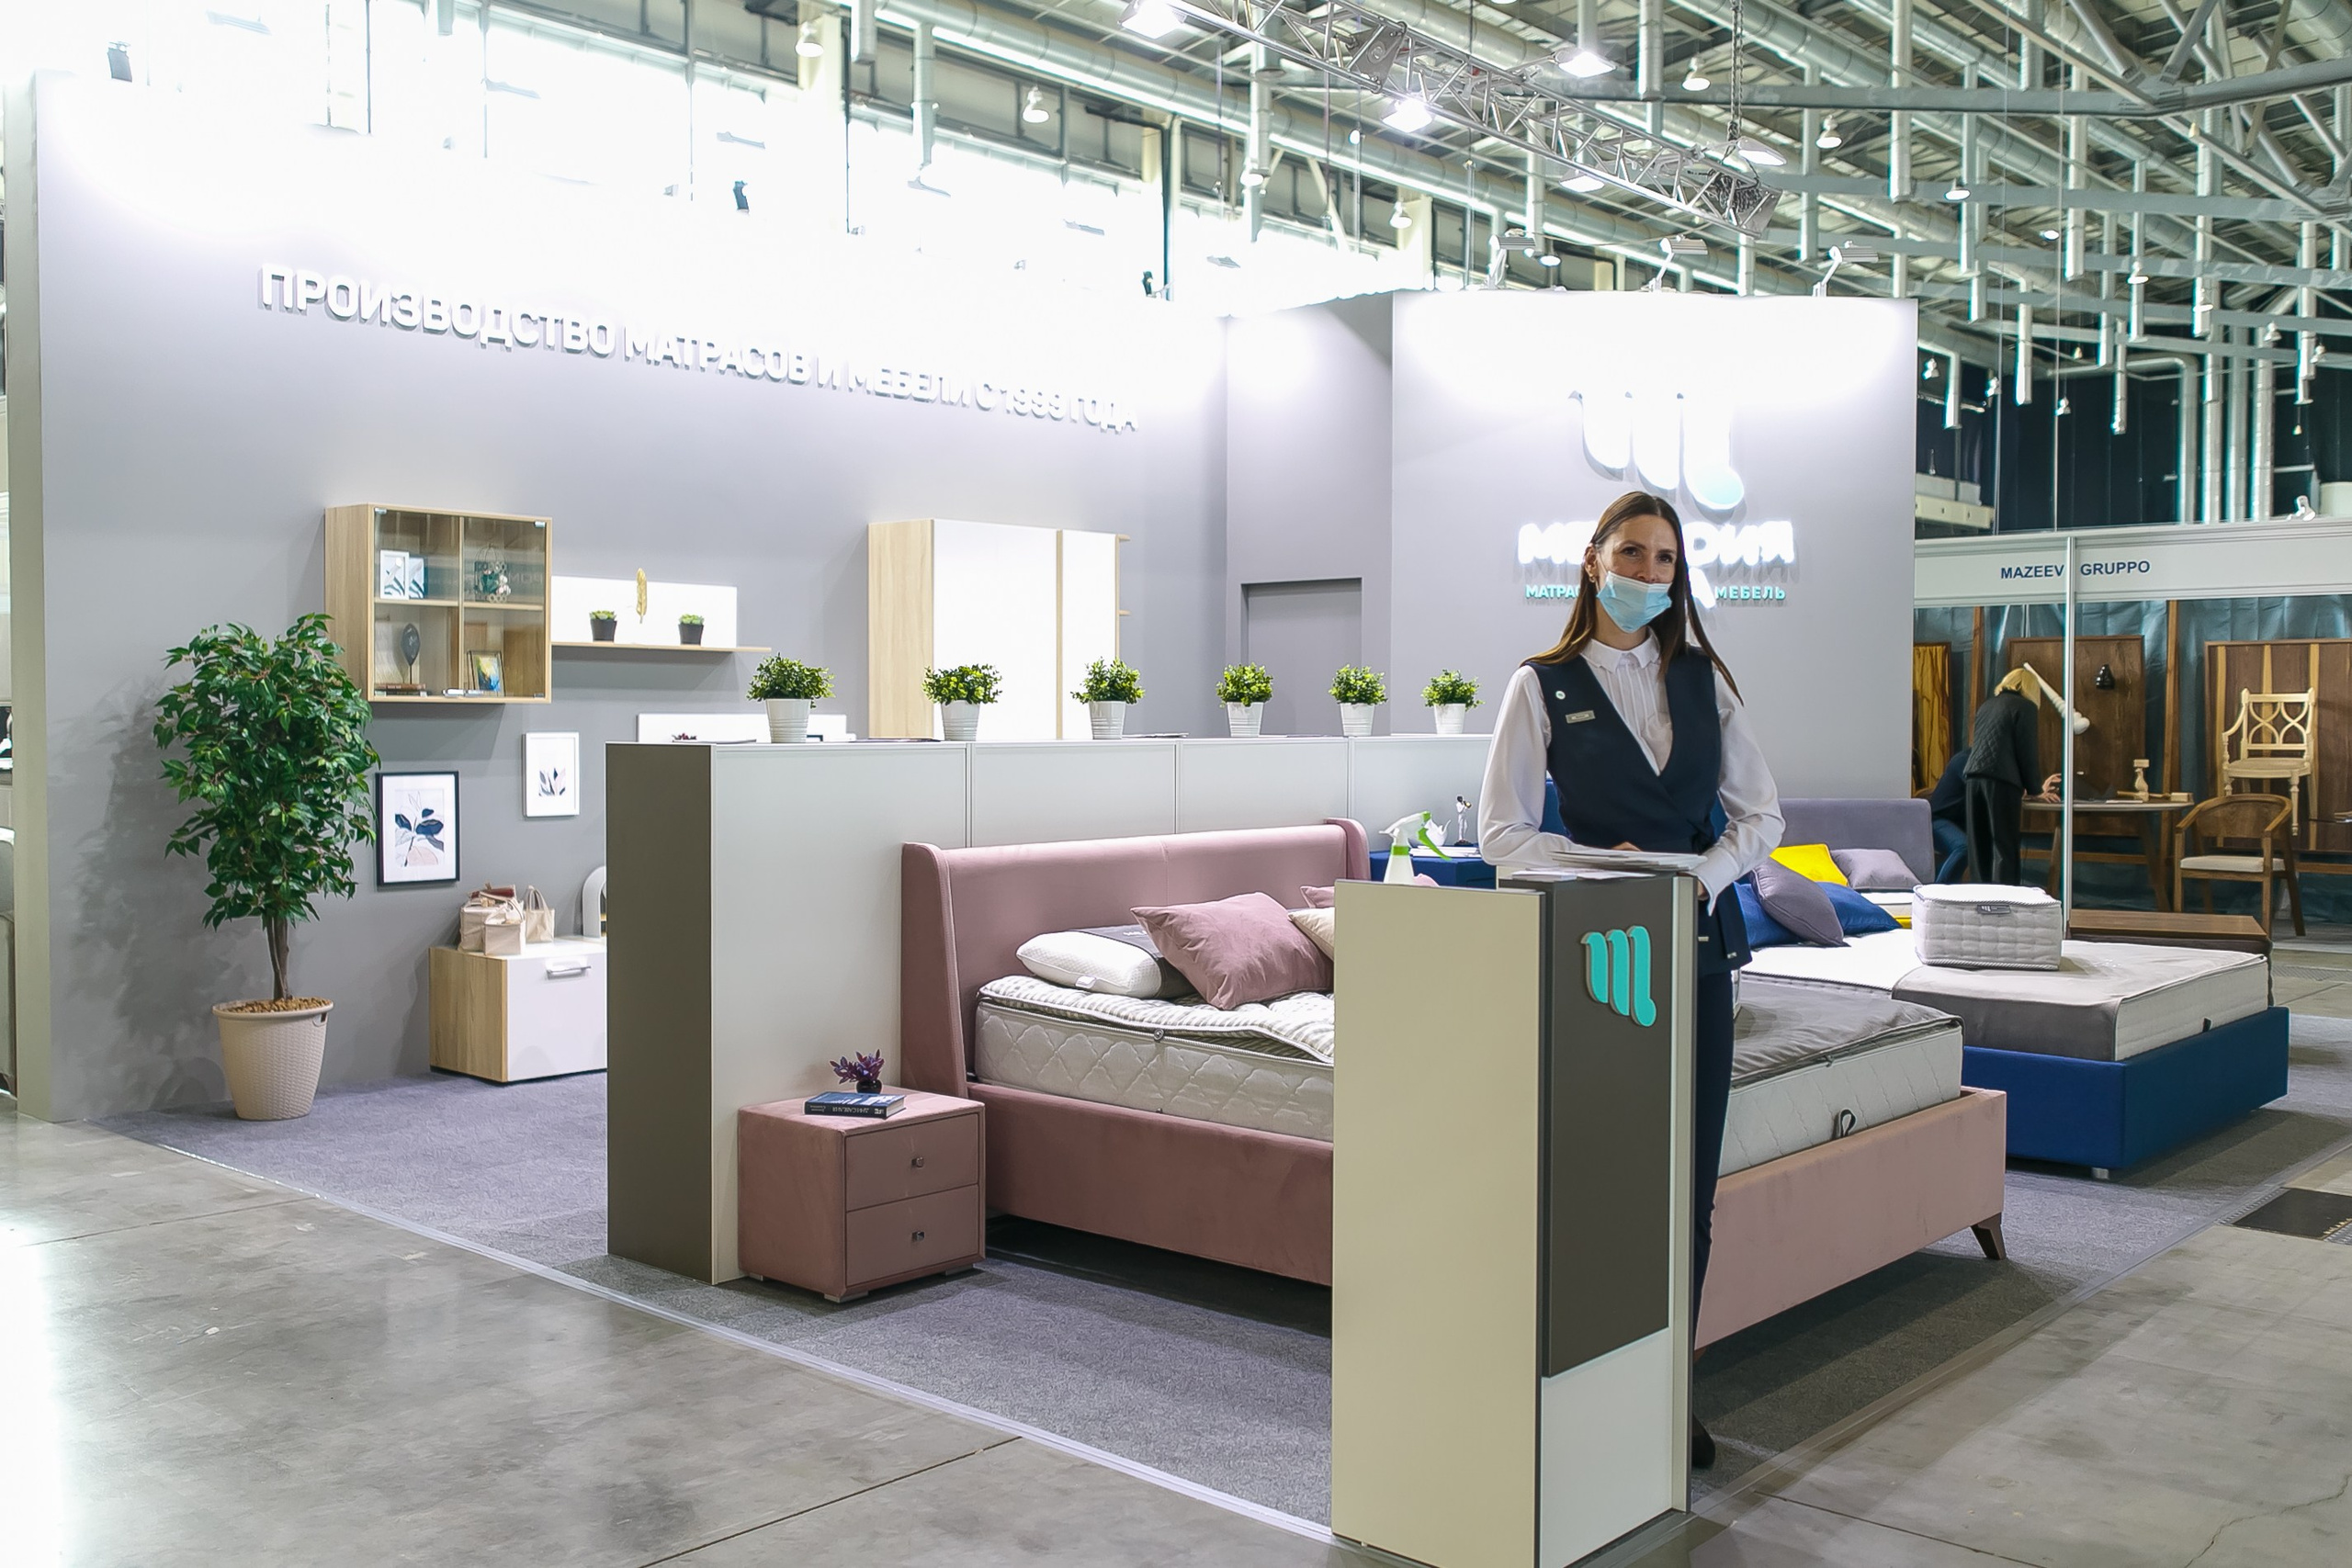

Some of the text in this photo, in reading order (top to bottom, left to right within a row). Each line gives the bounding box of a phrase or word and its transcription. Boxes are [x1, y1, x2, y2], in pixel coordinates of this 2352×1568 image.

[260, 264, 1139, 433] ПРОИЗВОДСТВО МАТРАСОВ И МЕБЕЛИ С 1999 ГОДА
[2000, 560, 2151, 580] MAZEEV GRUPPO
[1714, 585, 1787, 600] МЕБЕЛЬ
